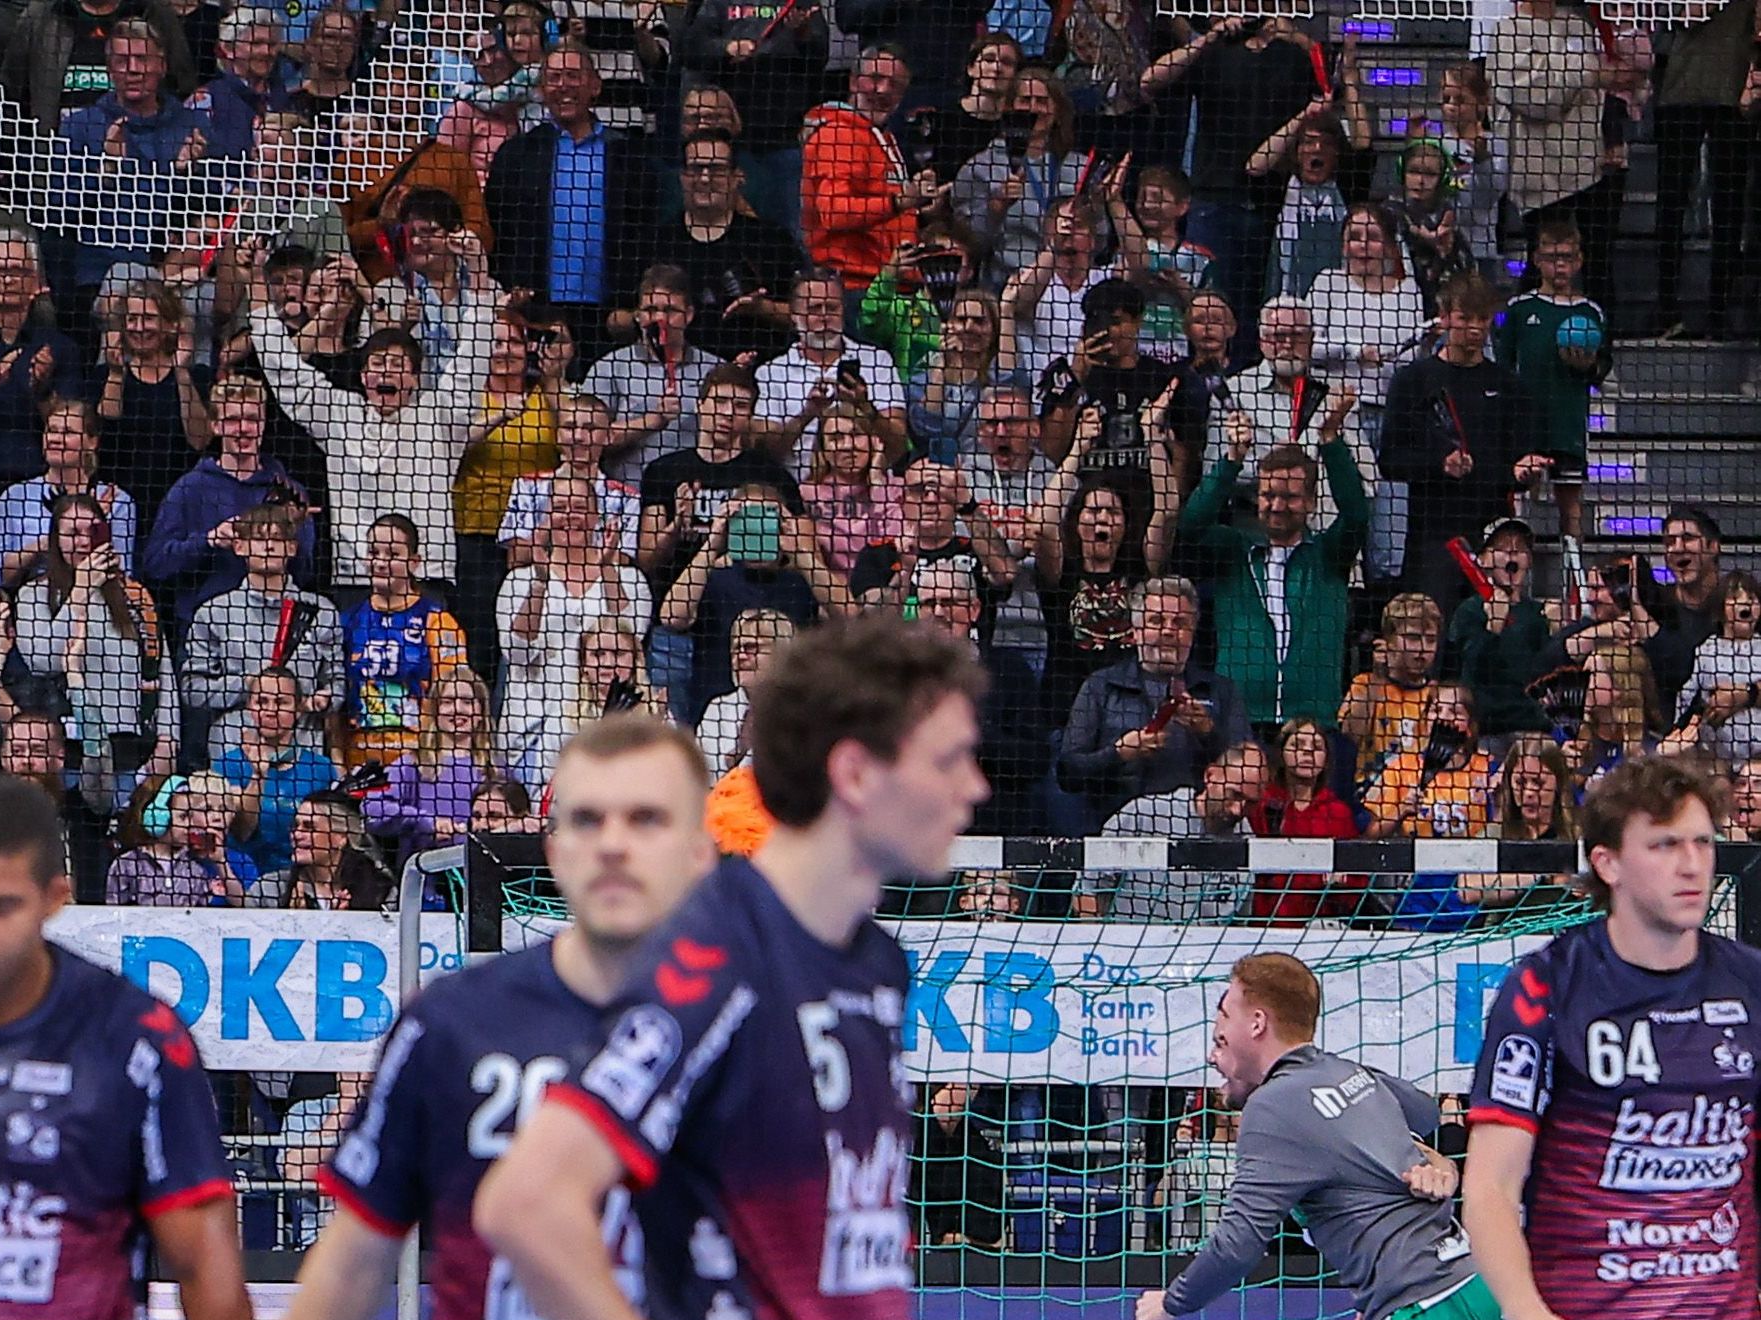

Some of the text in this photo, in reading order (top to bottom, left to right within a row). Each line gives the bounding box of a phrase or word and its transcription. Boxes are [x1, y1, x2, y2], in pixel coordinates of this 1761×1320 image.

[121, 935, 393, 1042] DKB
[1082, 953, 1139, 982] Das
[1081, 991, 1155, 1020] kann
[796, 1000, 852, 1113] 5
[1081, 1026, 1159, 1058] Bank
[1587, 1019, 1662, 1088] 64
